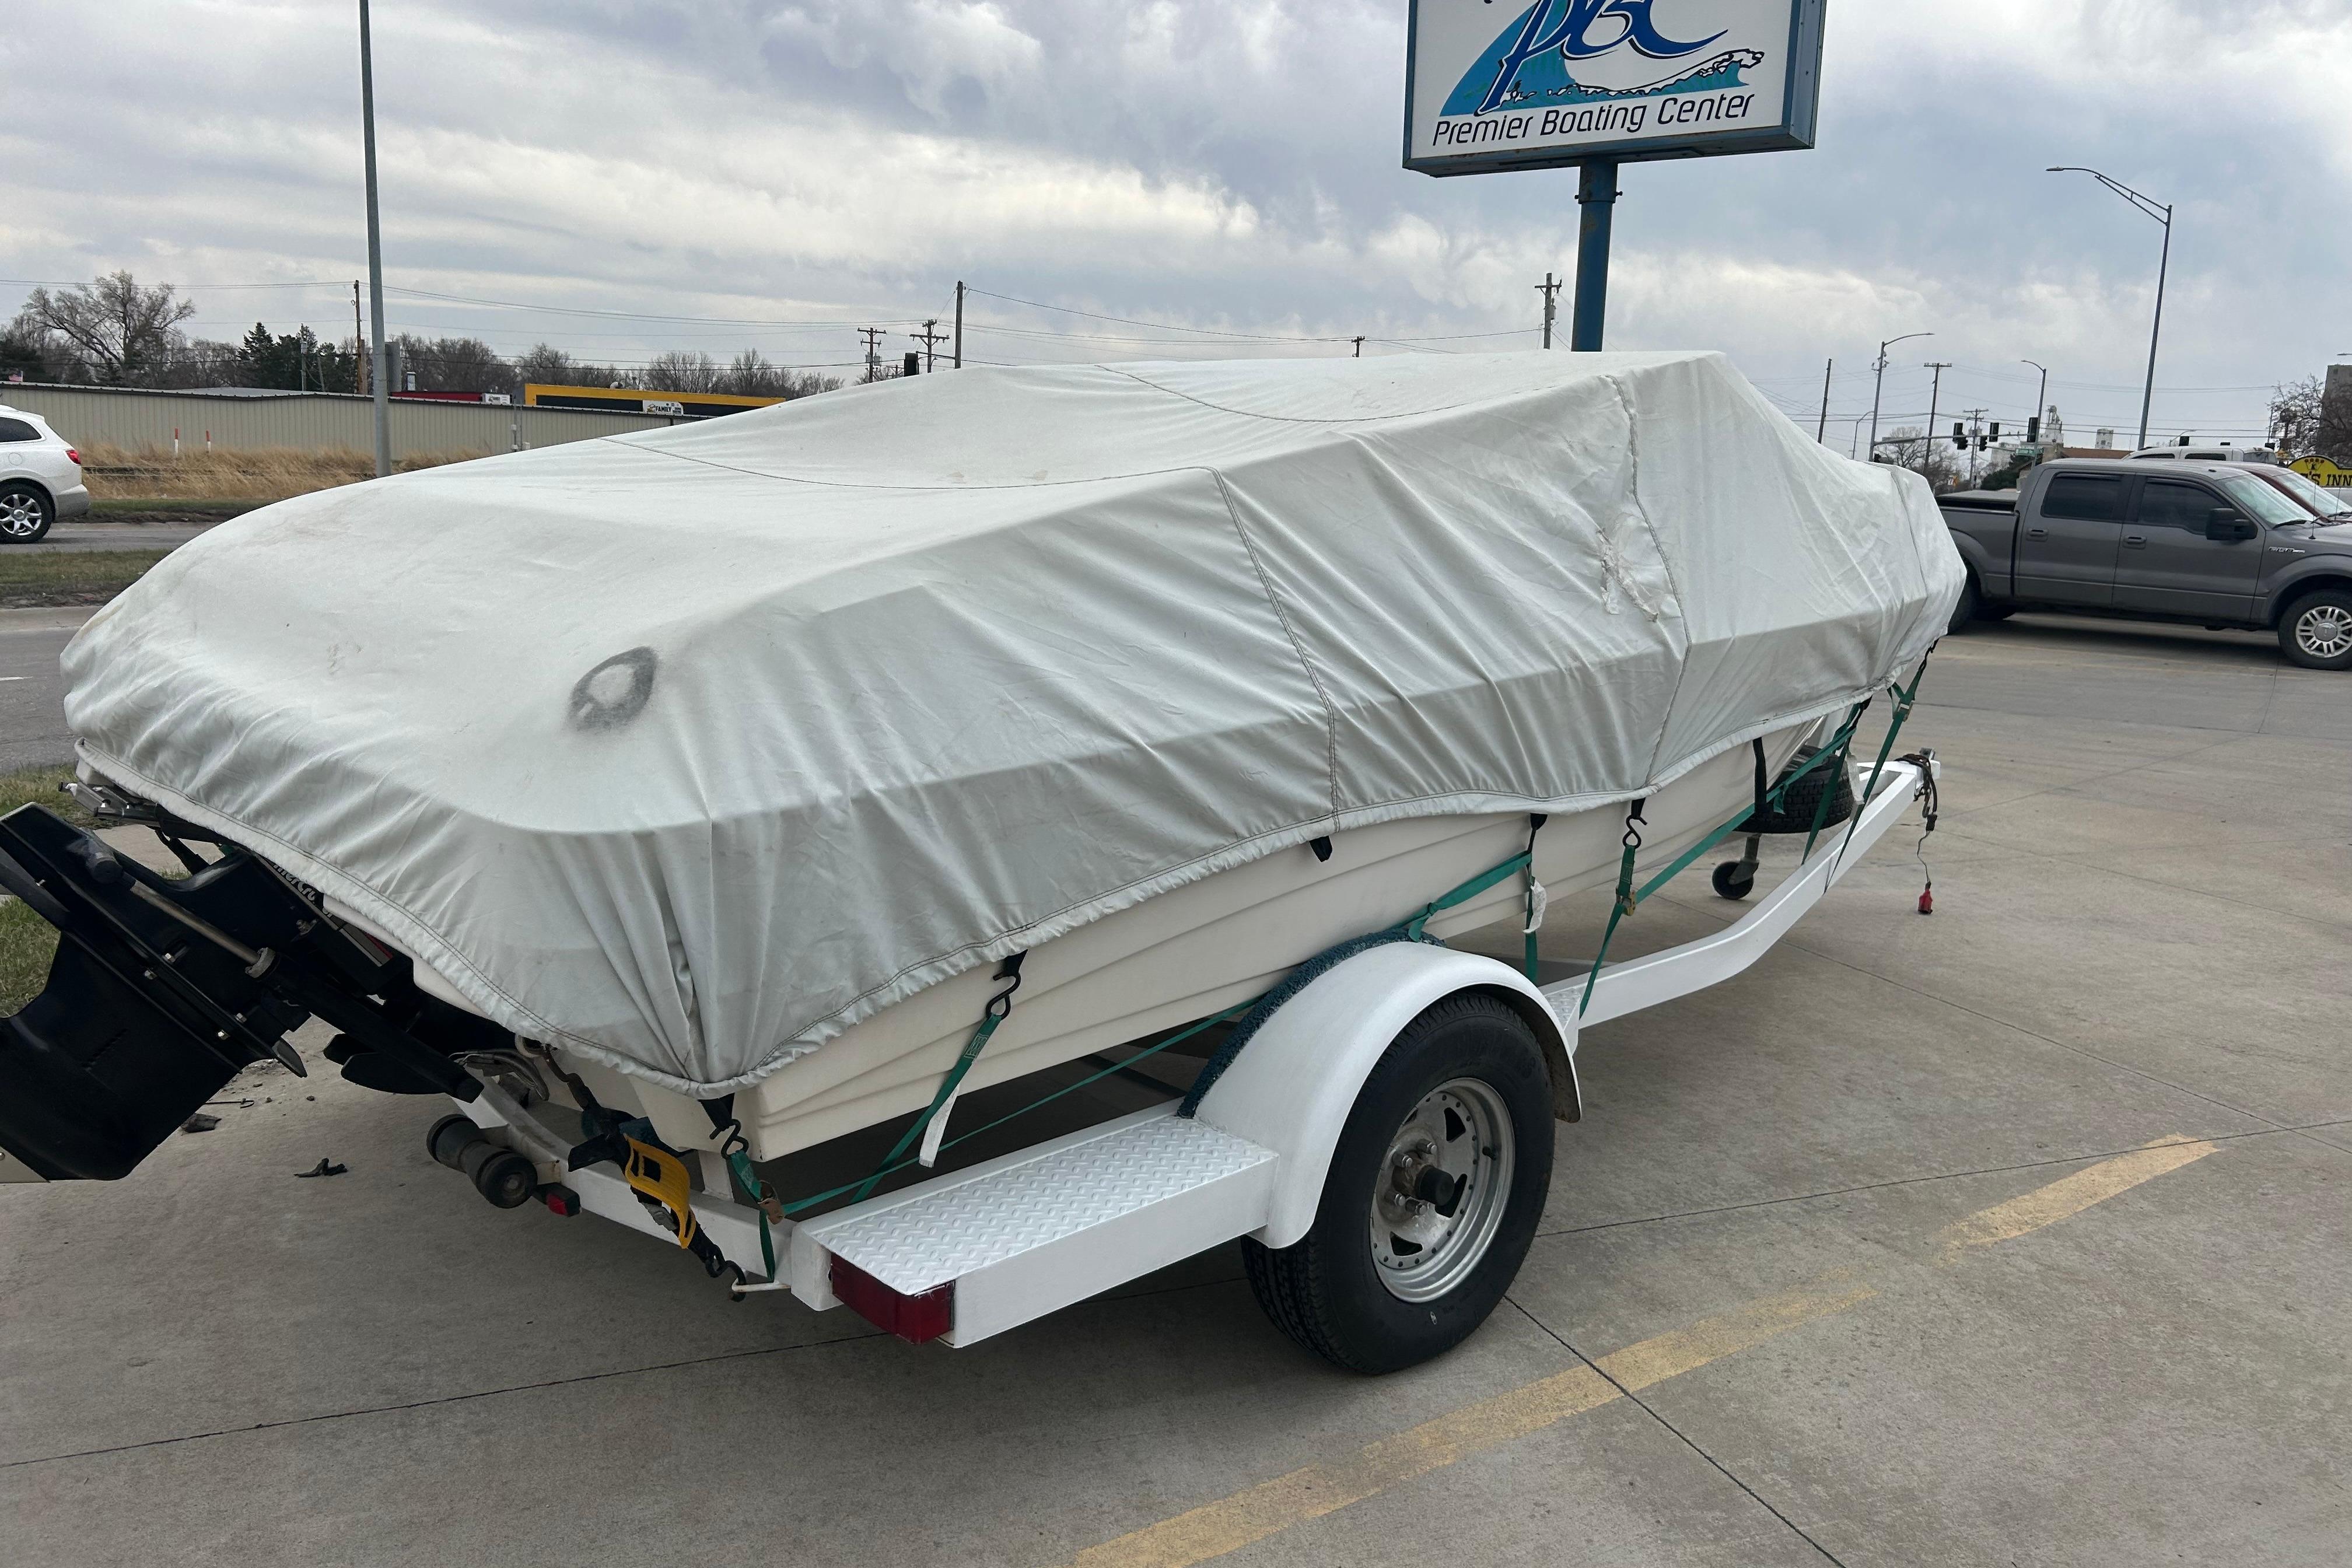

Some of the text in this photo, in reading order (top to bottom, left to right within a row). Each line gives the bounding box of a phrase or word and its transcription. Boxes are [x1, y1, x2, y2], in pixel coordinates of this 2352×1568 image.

[1432, 93, 1755, 146] Premier Boating Center
[2326, 474, 2352, 486] INN
